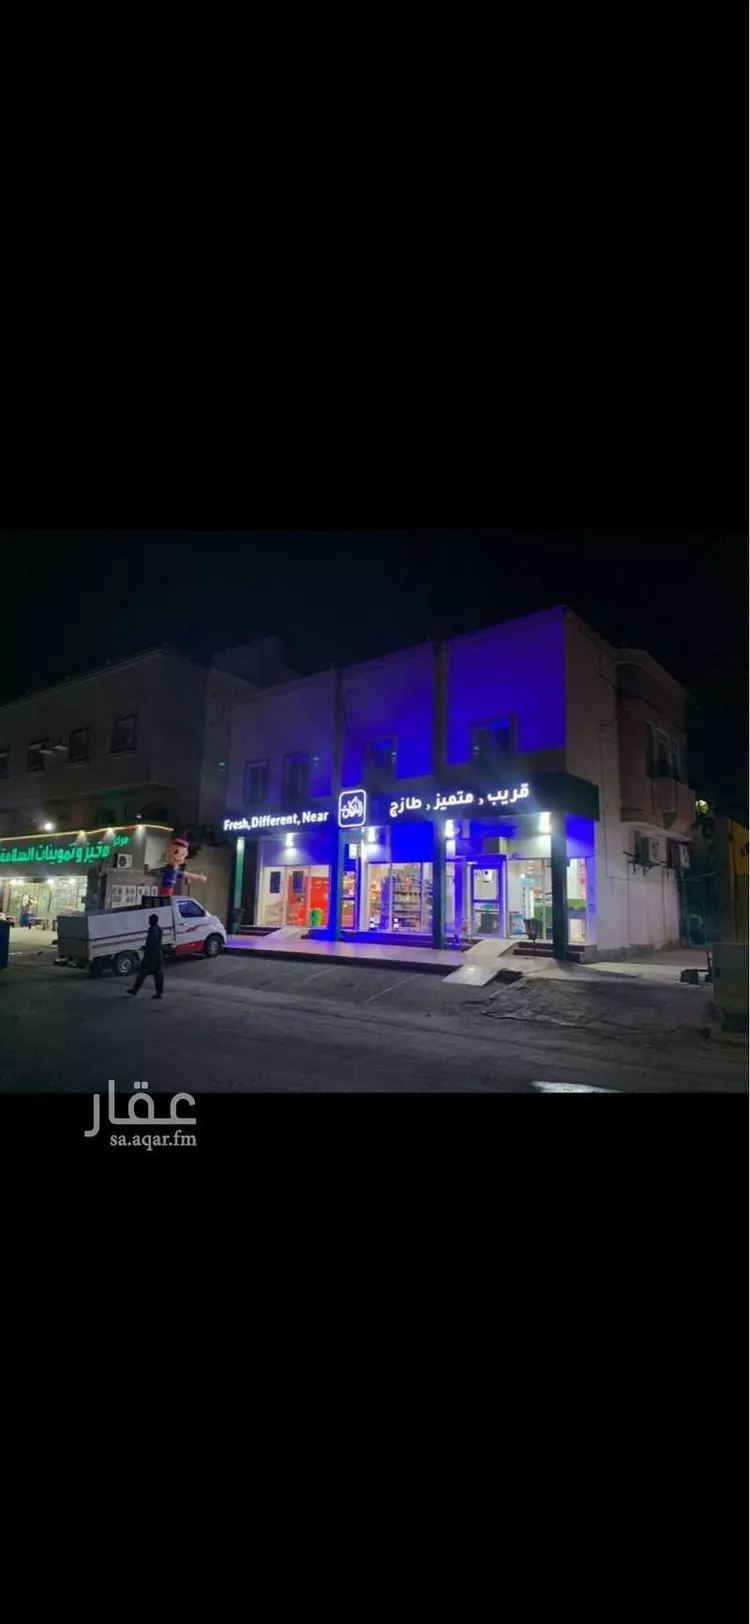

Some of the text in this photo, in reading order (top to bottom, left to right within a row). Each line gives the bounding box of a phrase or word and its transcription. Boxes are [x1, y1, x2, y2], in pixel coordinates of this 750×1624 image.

[433, 790, 474, 811] متميز
[487, 782, 530, 806] قريب
[302, 810, 329, 824] Near
[389, 796, 422, 818] طازج
